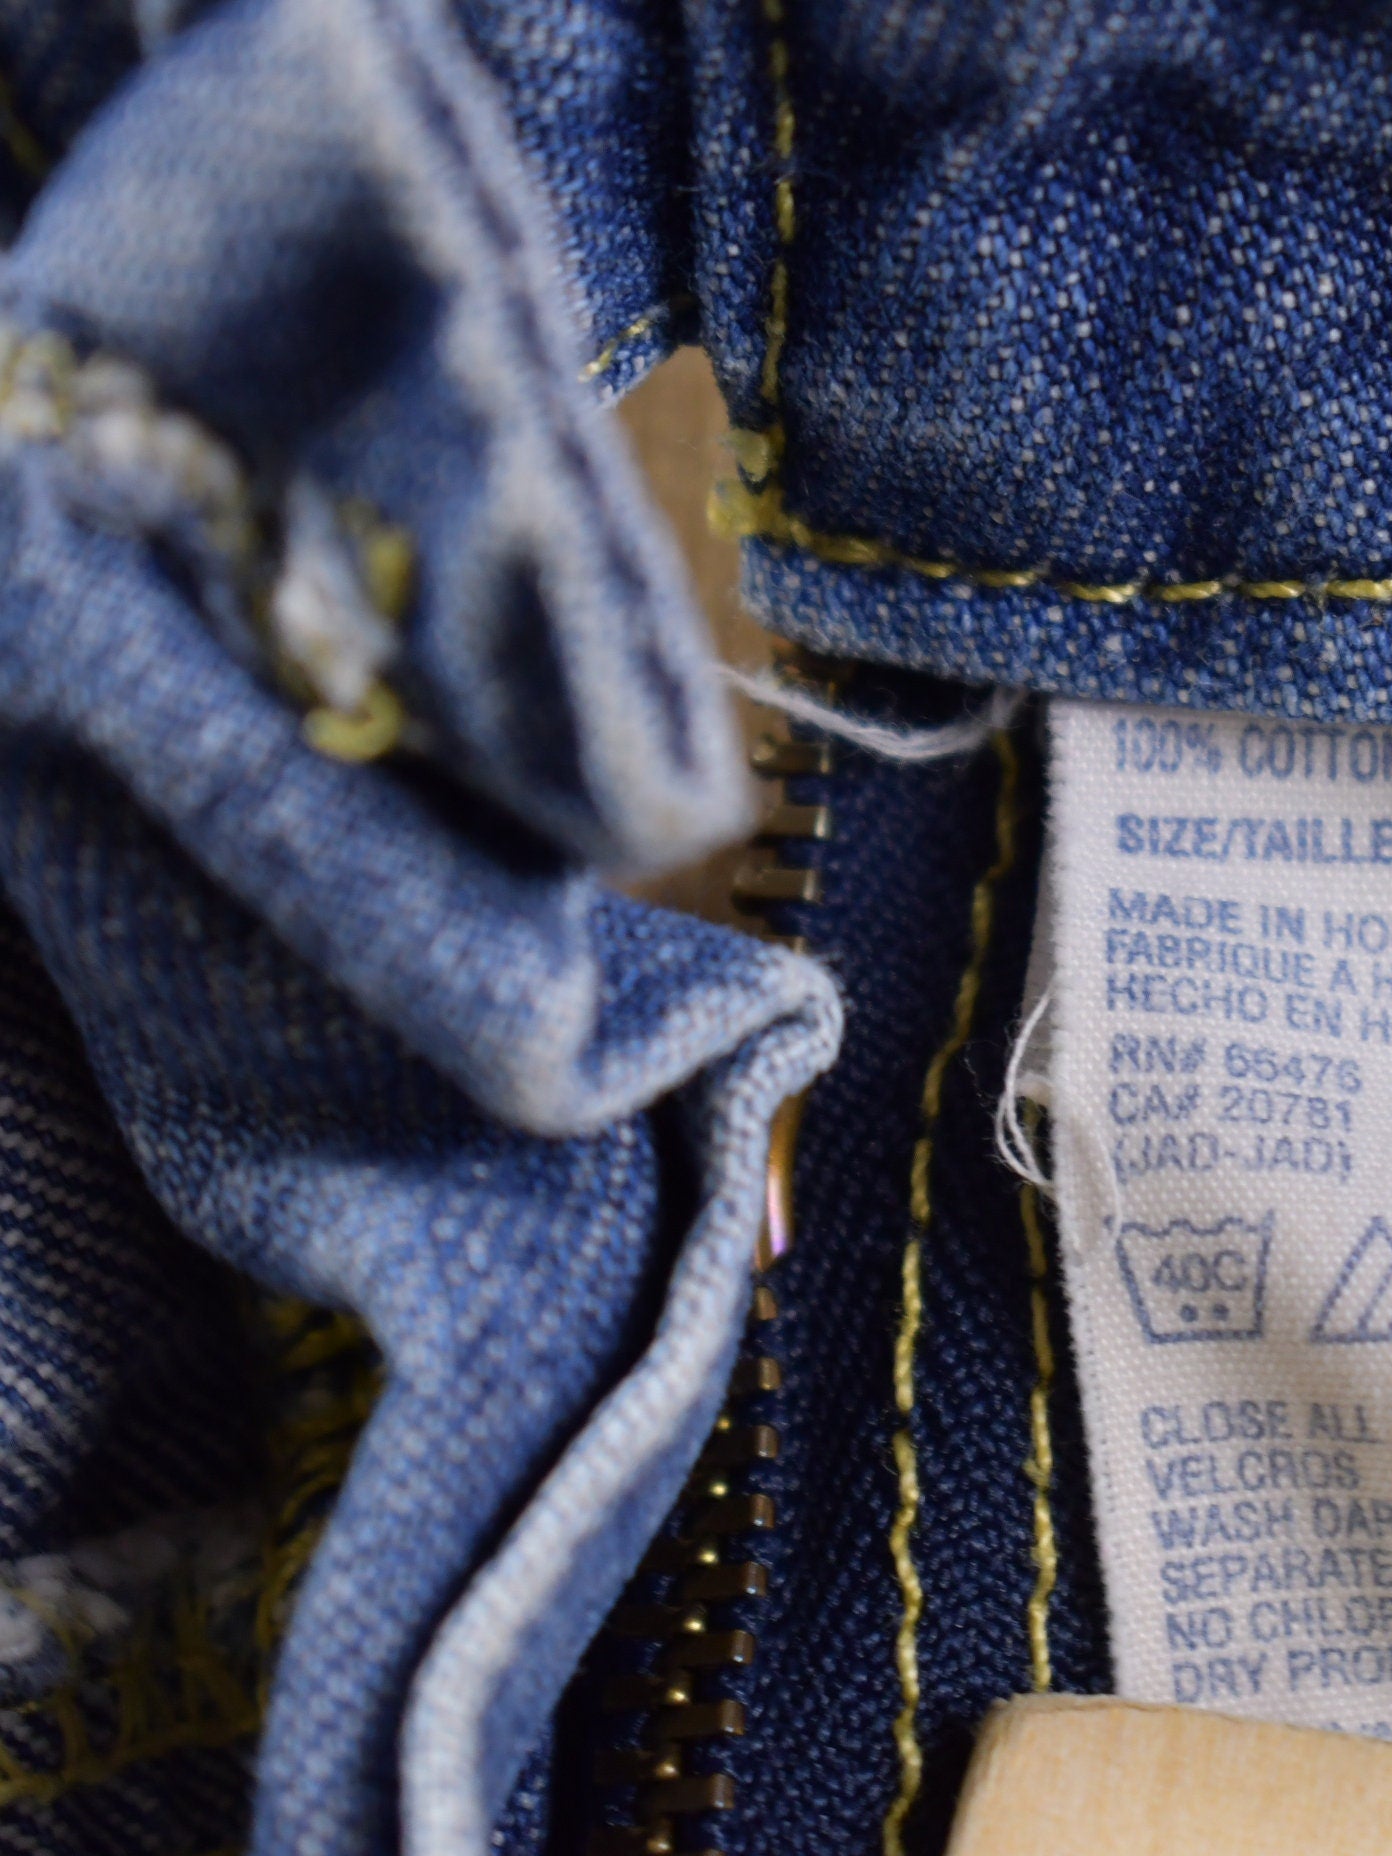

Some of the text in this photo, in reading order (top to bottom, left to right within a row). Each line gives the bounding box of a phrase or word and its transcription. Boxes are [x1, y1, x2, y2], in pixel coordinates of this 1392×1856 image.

[1112, 717, 1222, 775] 100%
[1108, 887, 1242, 935] MADE
[1260, 904, 1306, 945] IN
[1105, 927, 1317, 989] FABRIQUE
[1329, 958, 1358, 996] A
[1106, 972, 1269, 1023] HECHO
[1285, 993, 1343, 1038] EN
[1109, 1032, 1363, 1095] RN# 65476
[1108, 1081, 1353, 1133] CA# 20781
[1152, 1249, 1248, 1293] 40C
[1140, 1400, 1293, 1450] CLOSE
[1308, 1402, 1383, 1444] ALL
[1145, 1449, 1361, 1500] VELCROS
[1150, 1498, 1295, 1549] WASH
[1165, 1606, 1235, 1651] NO
[1172, 1651, 1269, 1703] DRY
